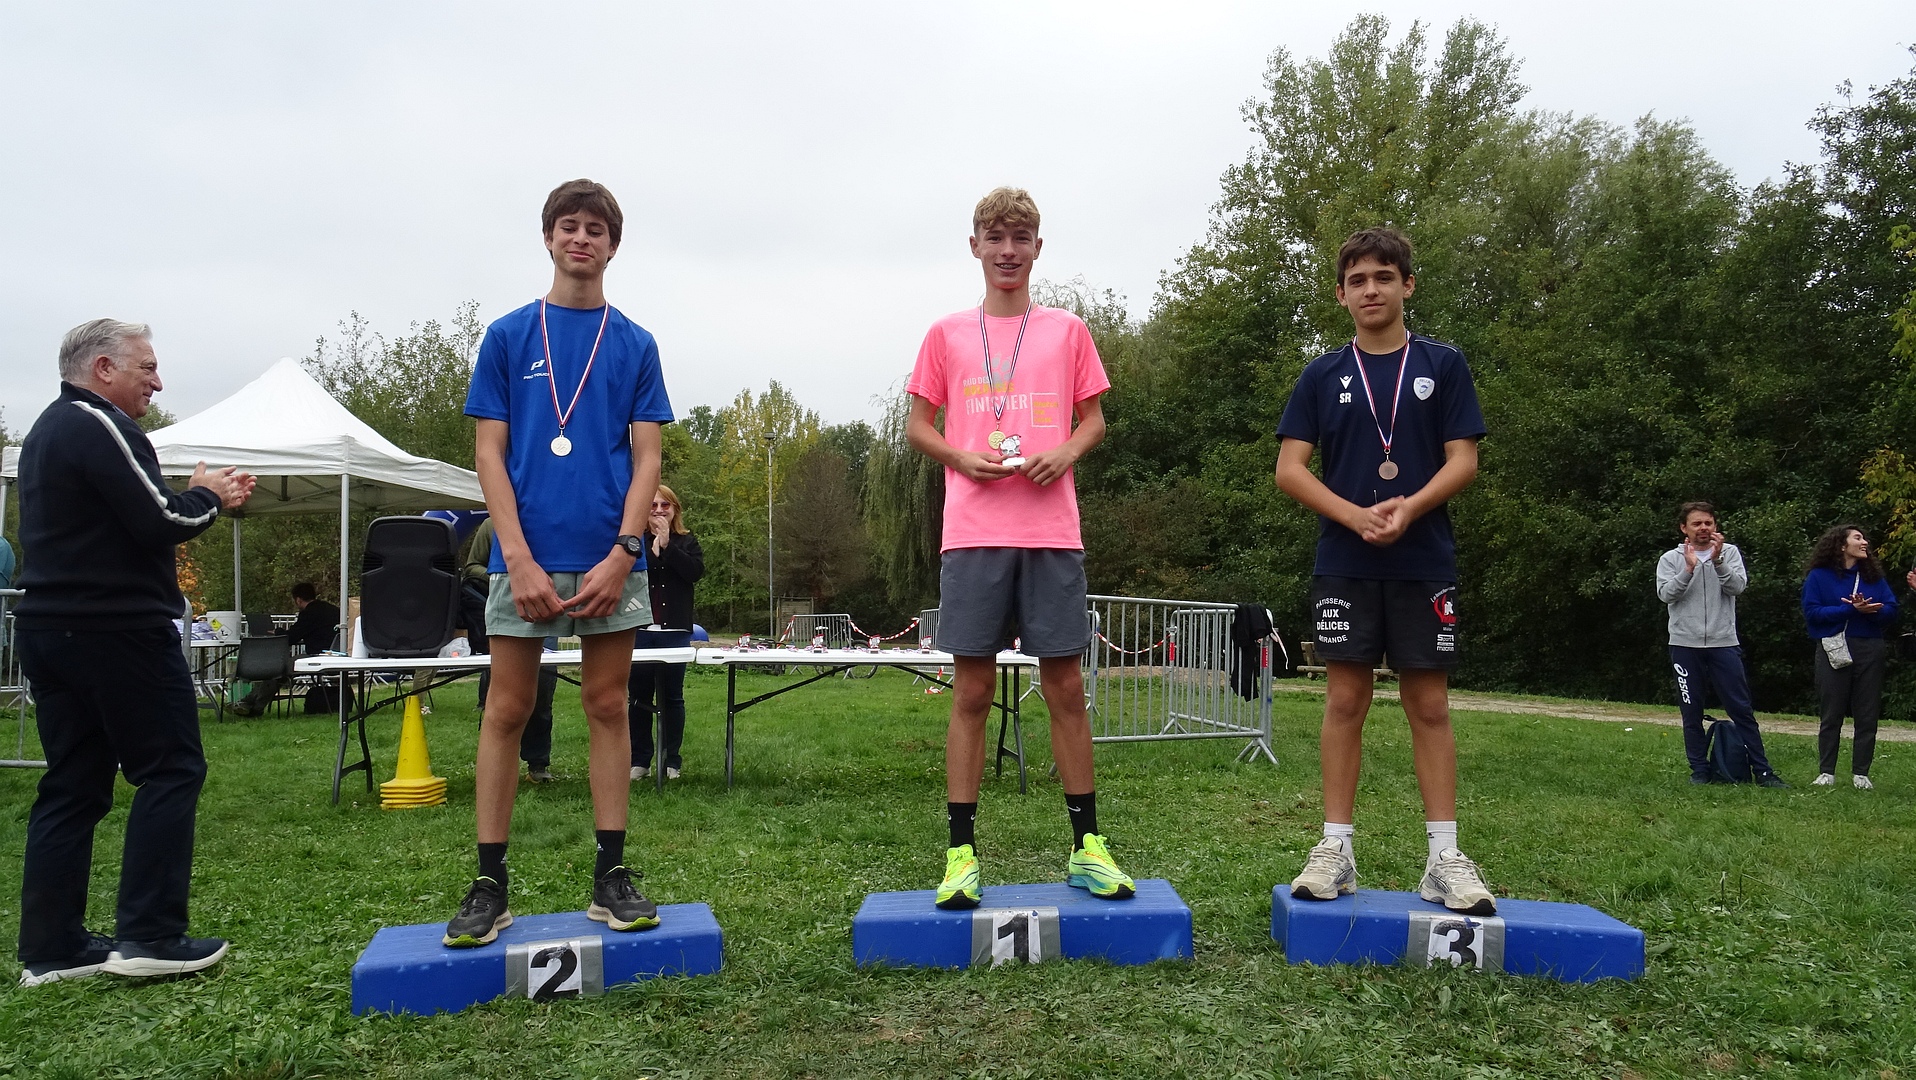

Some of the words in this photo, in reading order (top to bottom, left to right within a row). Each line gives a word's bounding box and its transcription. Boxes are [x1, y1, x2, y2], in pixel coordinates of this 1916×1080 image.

[965, 394, 1028, 415] FINISHER
[1339, 392, 1352, 404] SR
[1316, 619, 1350, 631] DÉLICES
[1322, 608, 1340, 618] AUX
[1678, 676, 1691, 704] asics
[997, 912, 1029, 966] 1
[1433, 919, 1477, 971] 3
[530, 946, 579, 1004] 2
